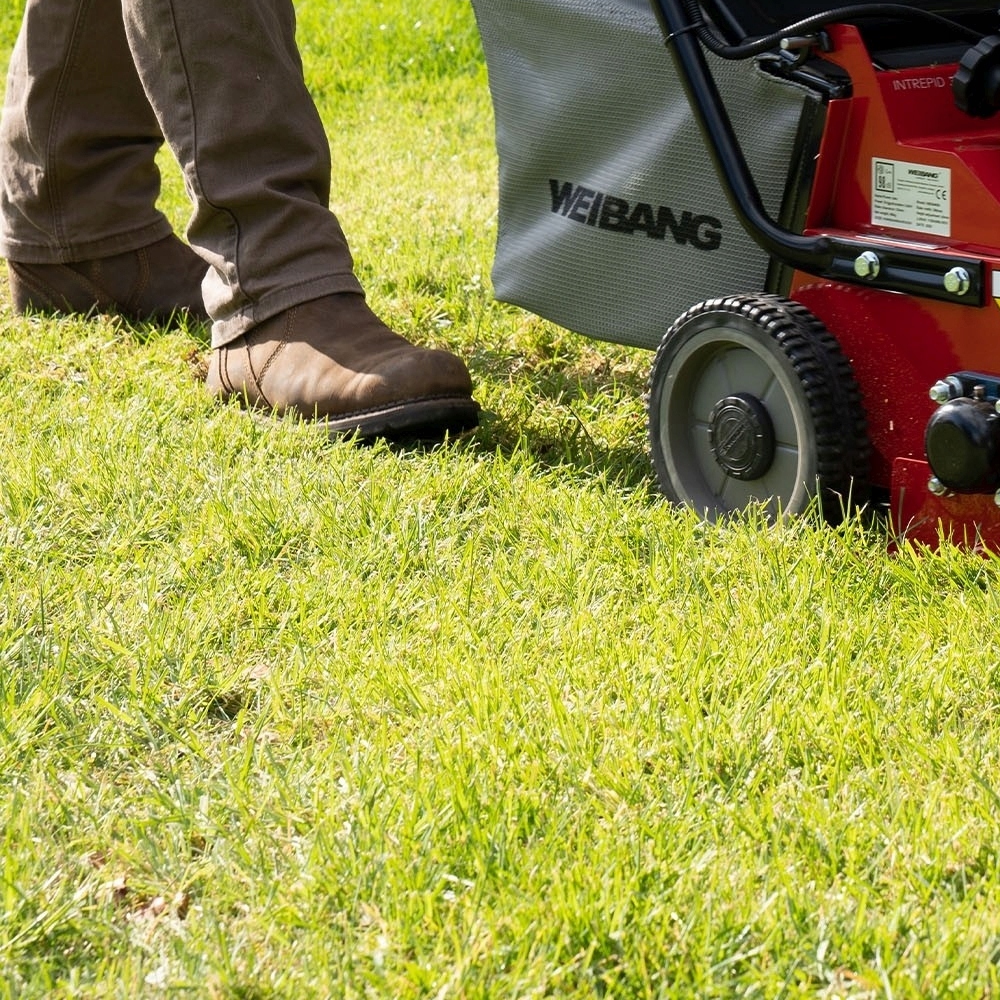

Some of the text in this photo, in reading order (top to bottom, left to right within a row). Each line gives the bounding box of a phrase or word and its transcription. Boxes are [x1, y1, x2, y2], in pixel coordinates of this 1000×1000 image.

[892, 76, 946, 91] INTREPID
[907, 168, 939, 179] WEIBANG
[548, 179, 723, 251] WEIBANG
